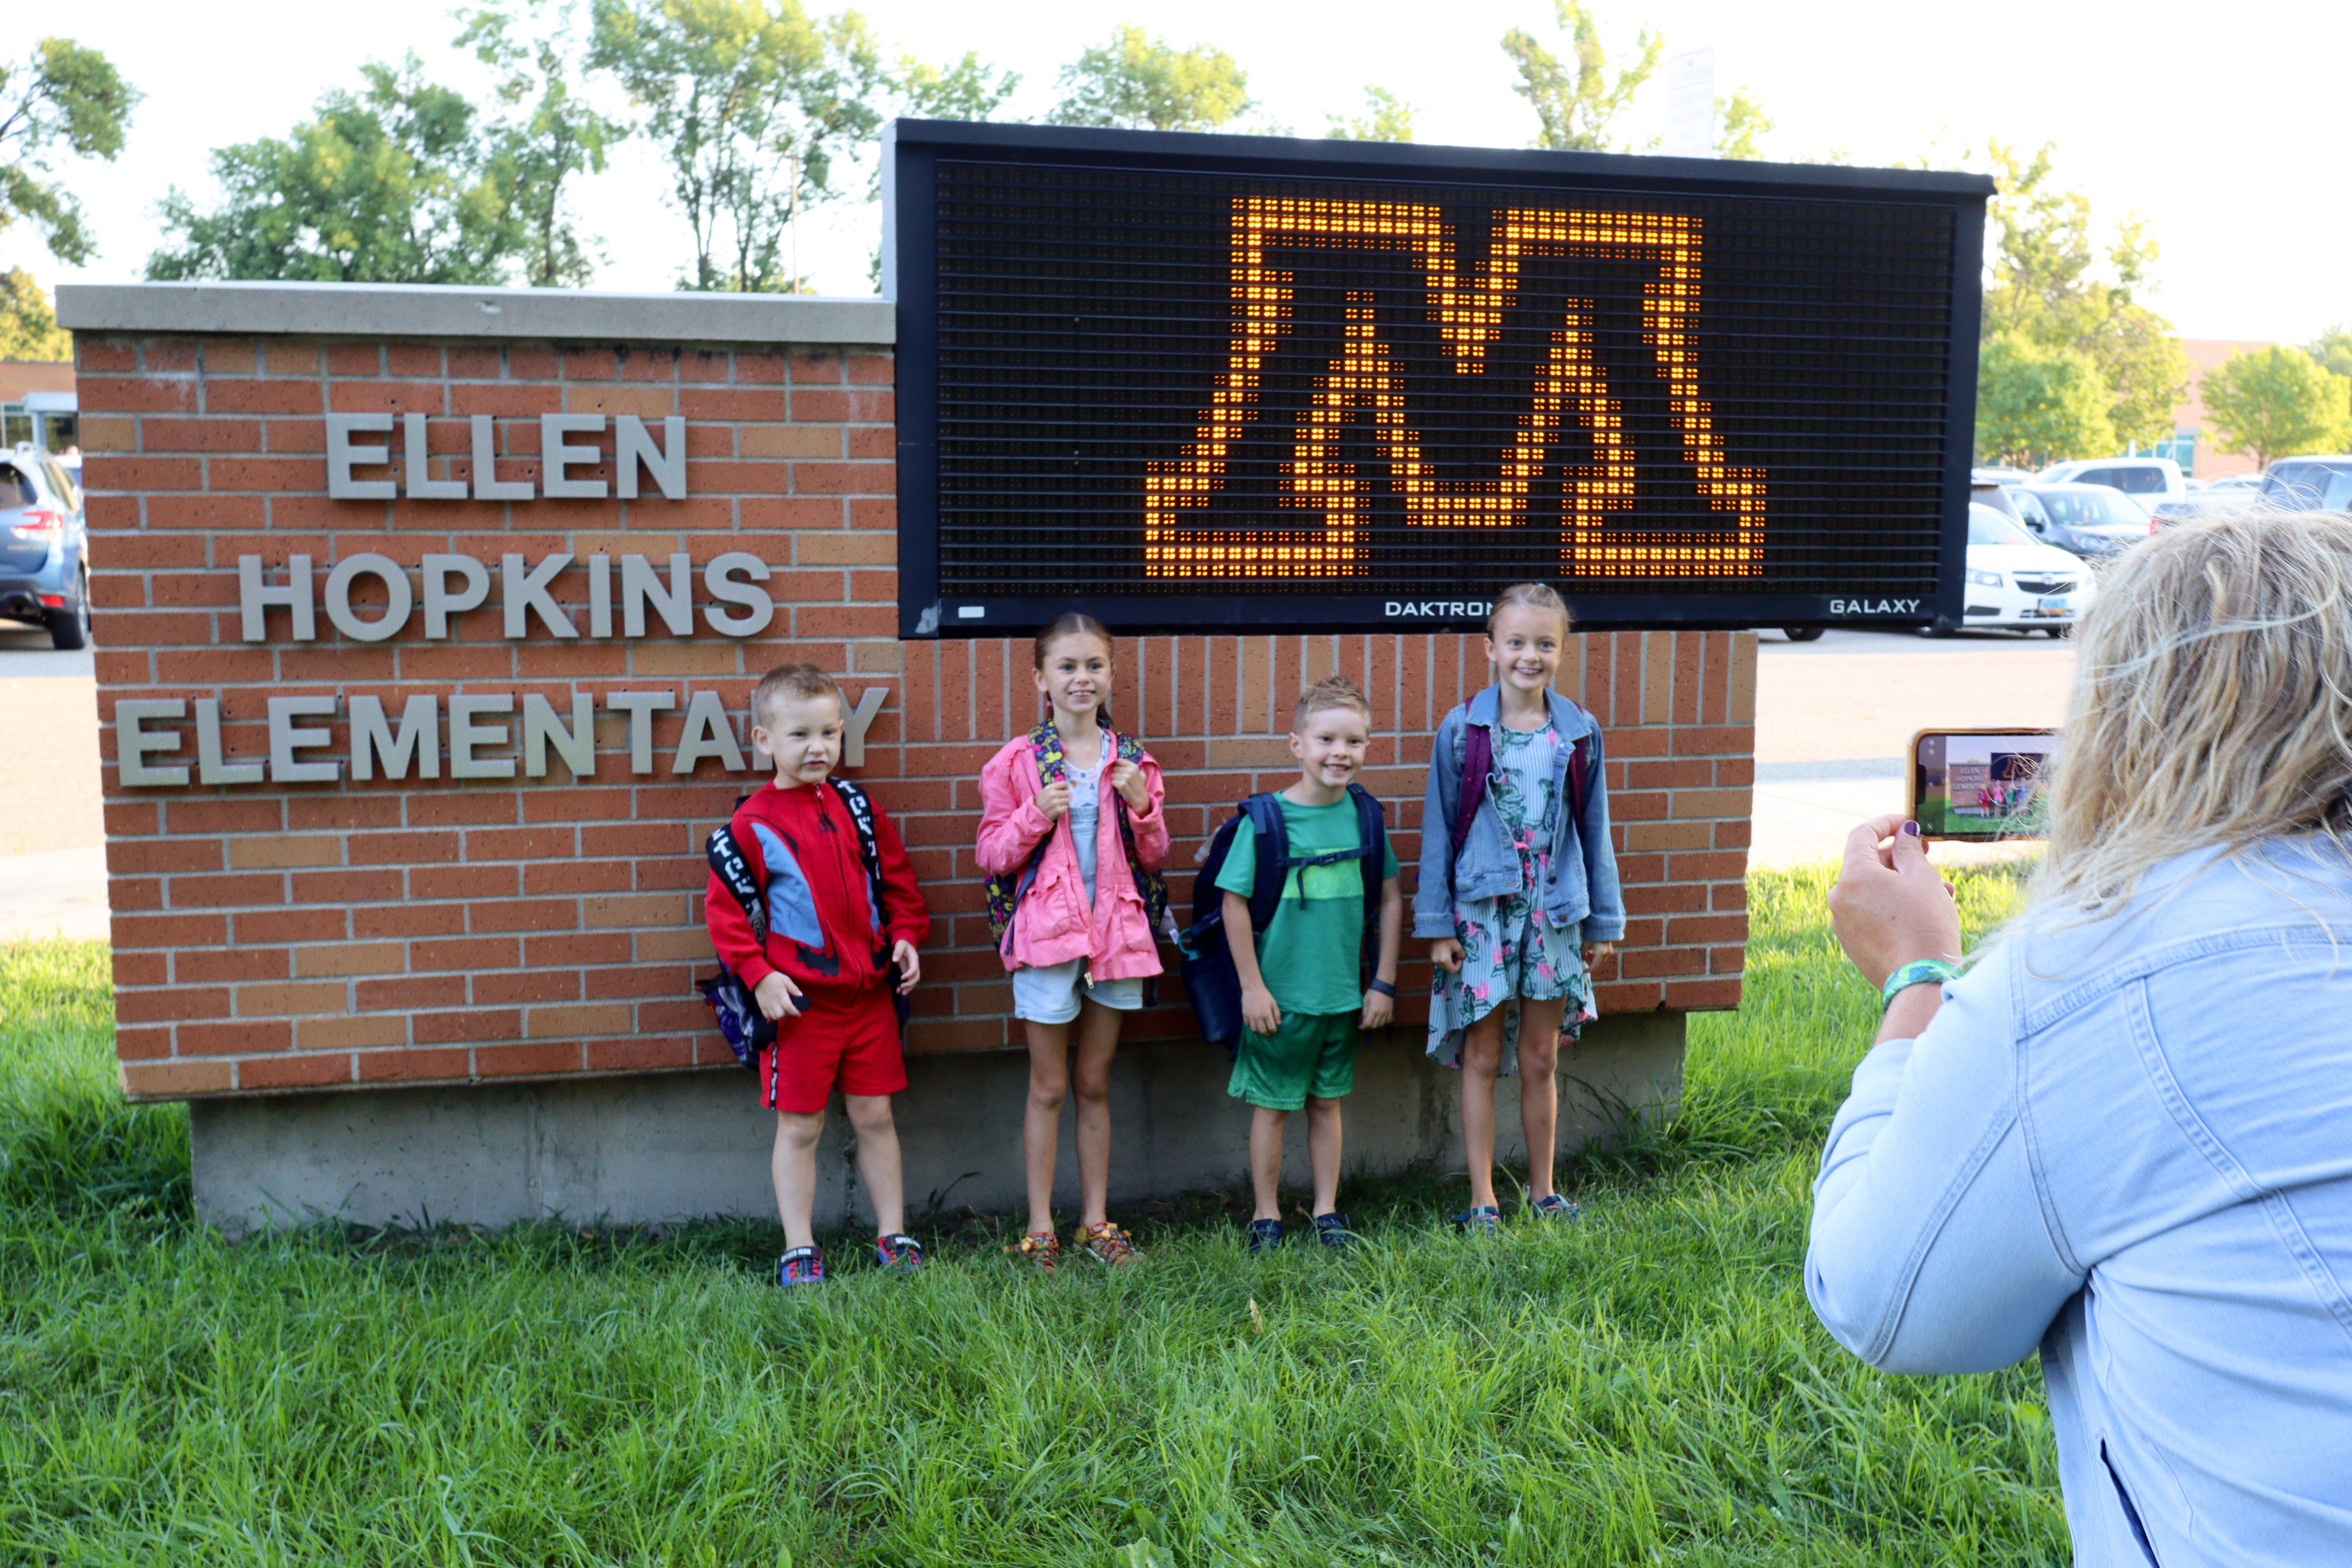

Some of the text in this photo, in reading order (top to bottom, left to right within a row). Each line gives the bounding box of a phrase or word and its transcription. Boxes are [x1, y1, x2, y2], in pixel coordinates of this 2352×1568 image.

[325, 412, 687, 501] ELLEN
[238, 552, 774, 642] HOPKINS
[1830, 599, 1920, 614] GALAXY
[115, 687, 890, 787] ELEMENTAY
